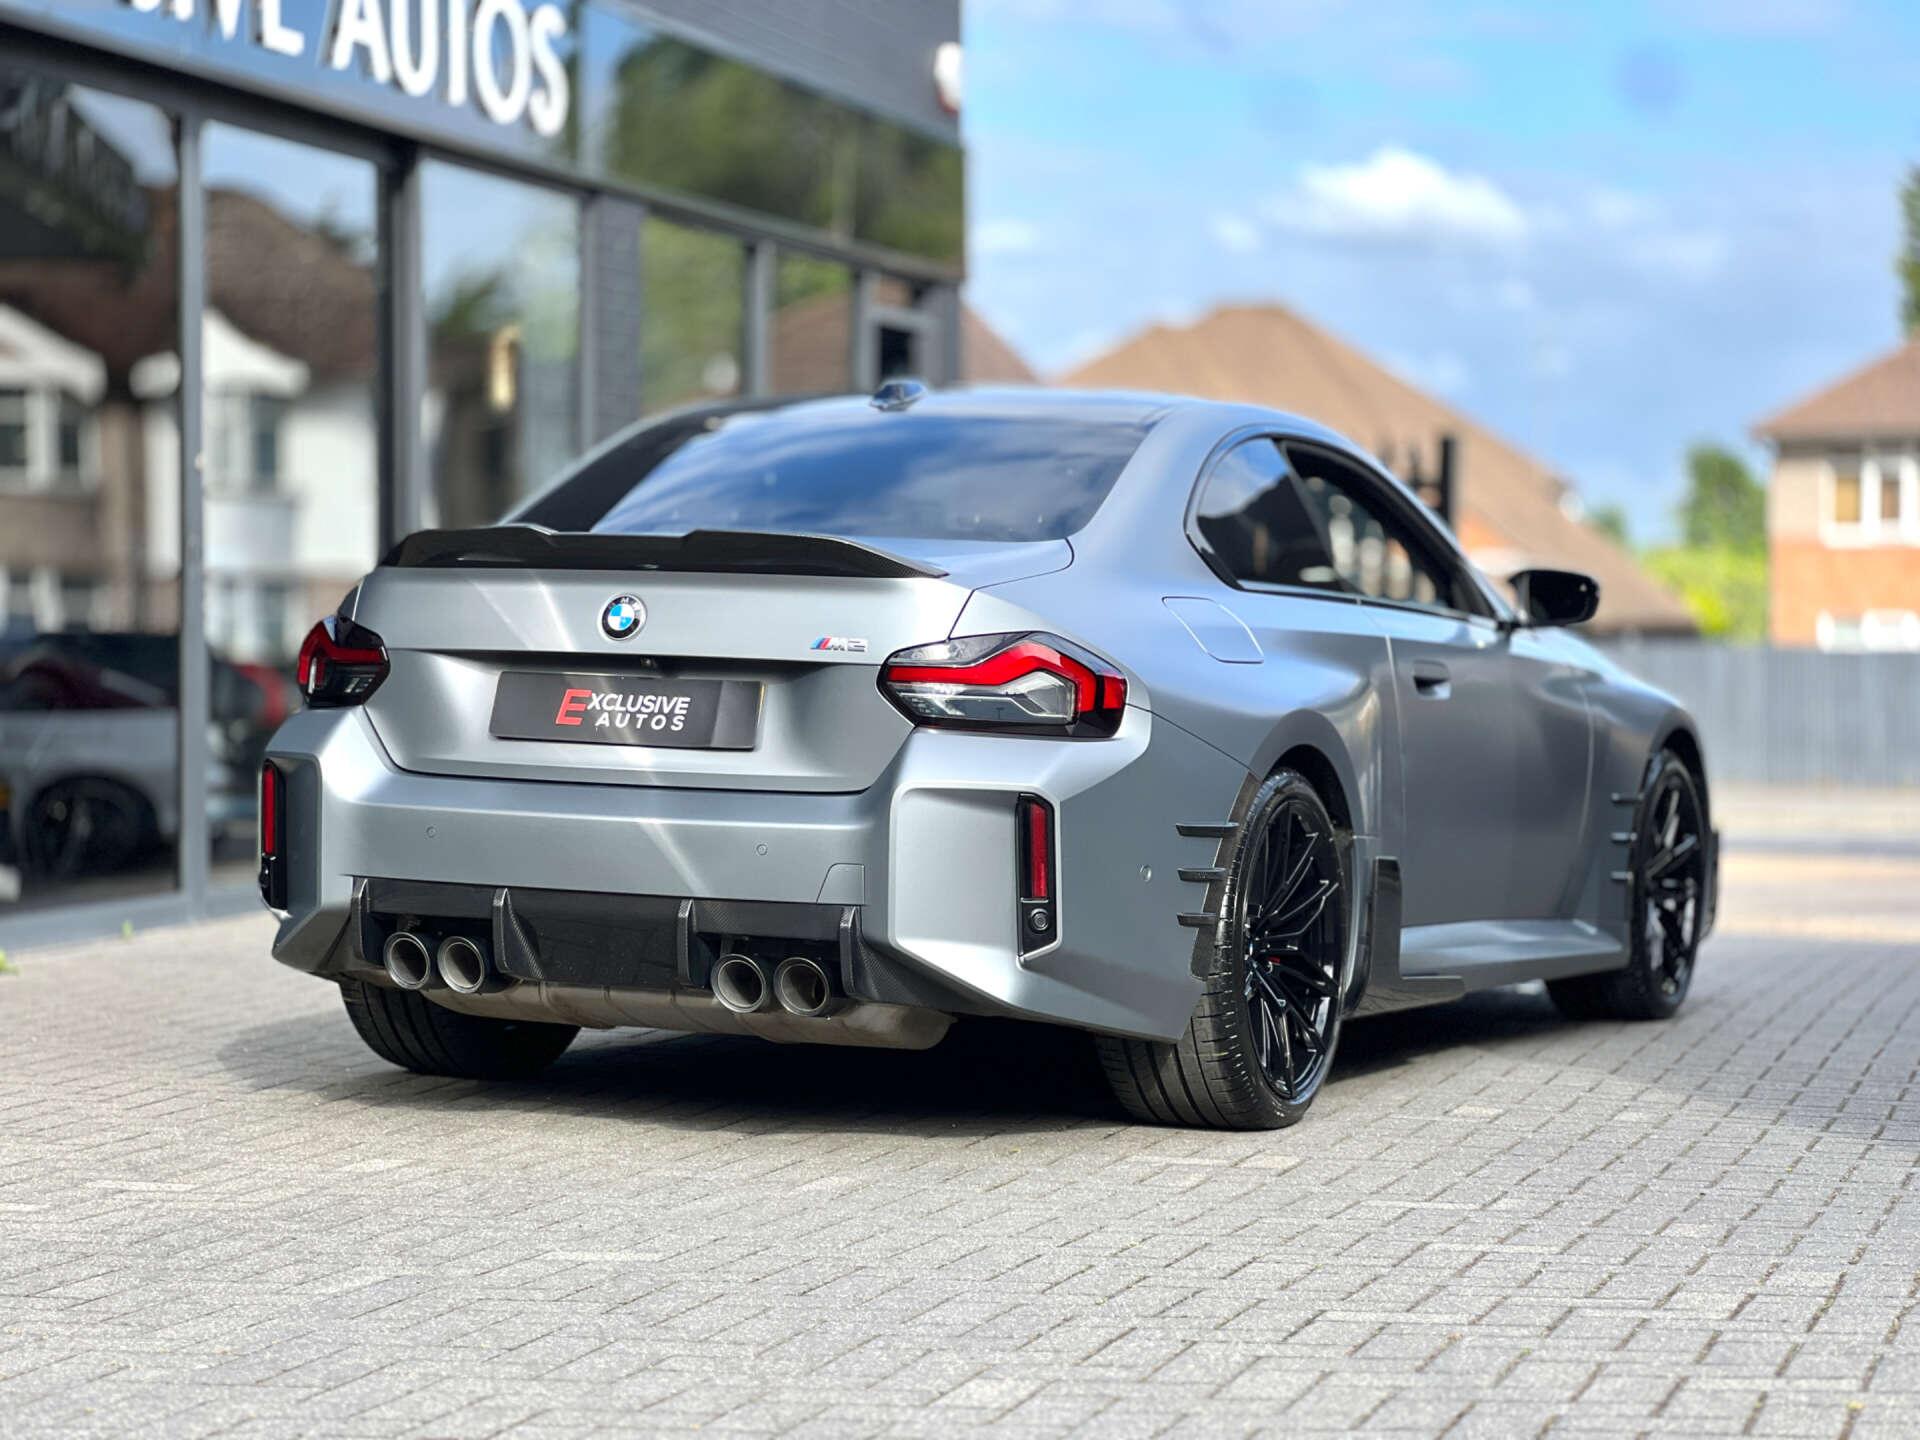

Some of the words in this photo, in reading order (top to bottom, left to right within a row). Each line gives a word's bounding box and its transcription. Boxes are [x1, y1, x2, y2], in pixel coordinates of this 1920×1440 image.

[829, 637, 869, 653] M2
[555, 688, 691, 726] EXCLUSIVE
[595, 711, 686, 731] AUTOS
